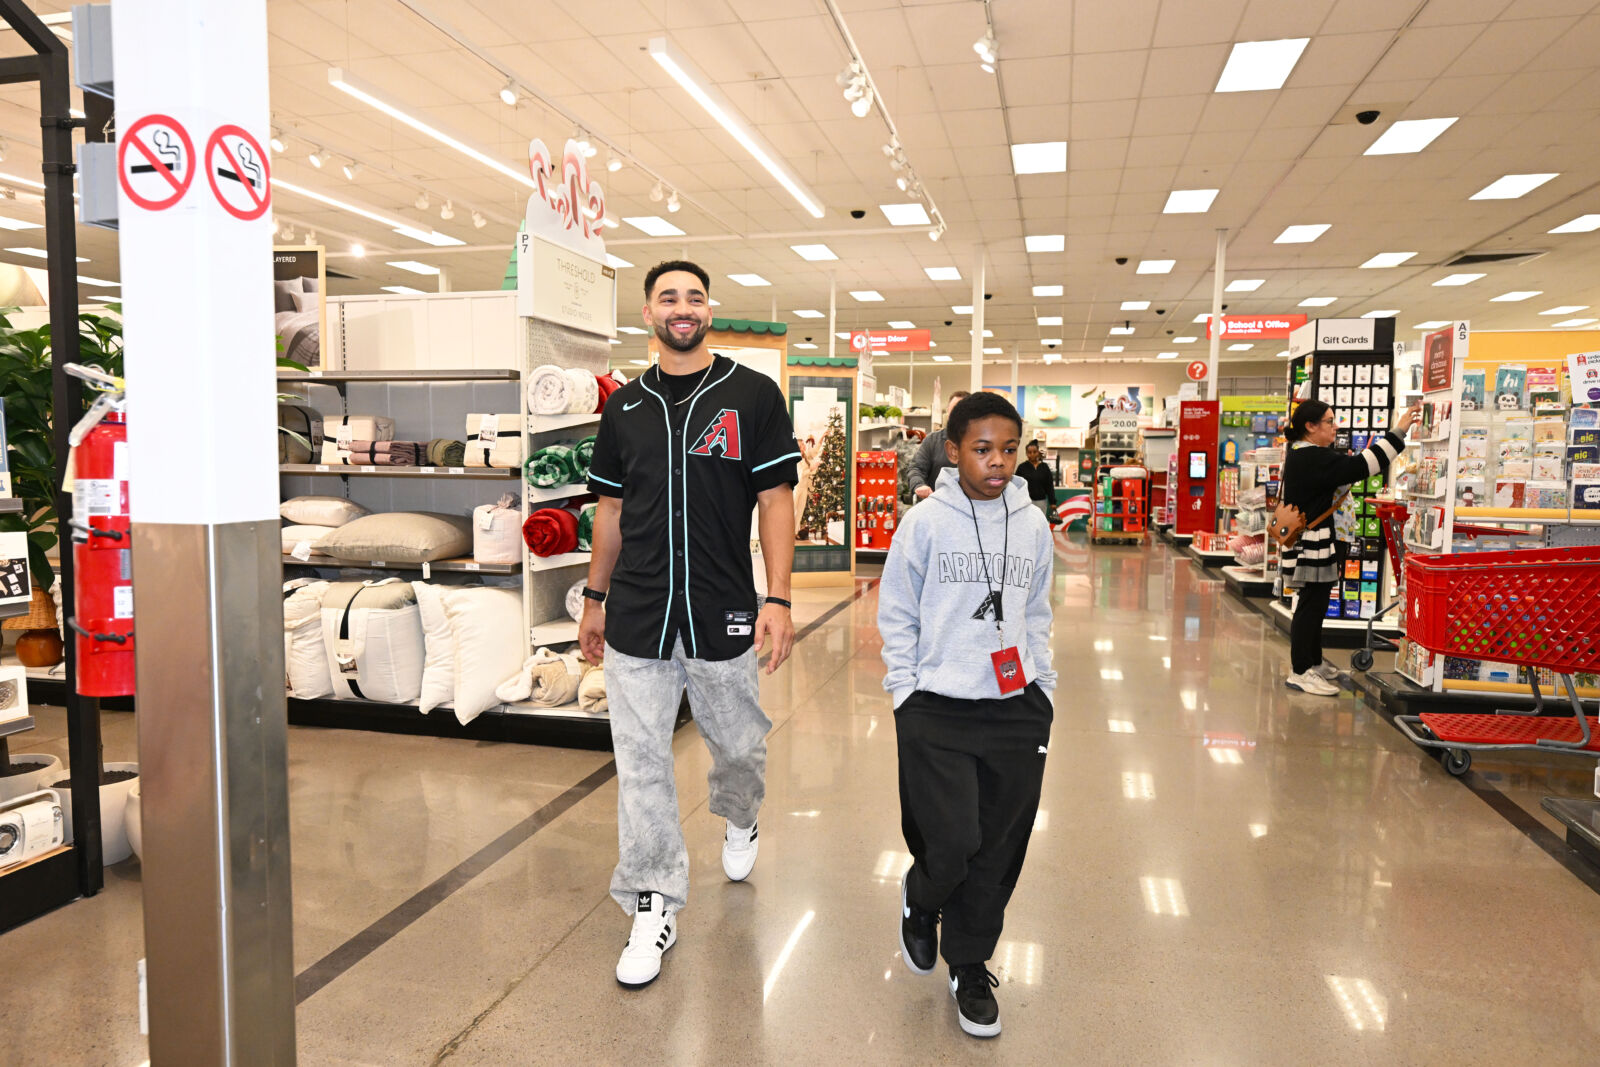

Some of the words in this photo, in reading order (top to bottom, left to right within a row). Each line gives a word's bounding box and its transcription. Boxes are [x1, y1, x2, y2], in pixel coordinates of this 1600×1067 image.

[522, 234, 529, 243] P
[522, 244, 528, 253] 7
[557, 258, 596, 284] THRESHOLD
[1227, 320, 1256, 329] School
[1257, 320, 1264, 329] &
[1265, 319, 1290, 329] Office
[1459, 322, 1467, 331] A
[1323, 336, 1340, 345] Gift
[1341, 335, 1369, 344] Cards
[1459, 331, 1466, 340] 5
[1503, 373, 1519, 388] hi
[938, 552, 1034, 589] ARIZONA
